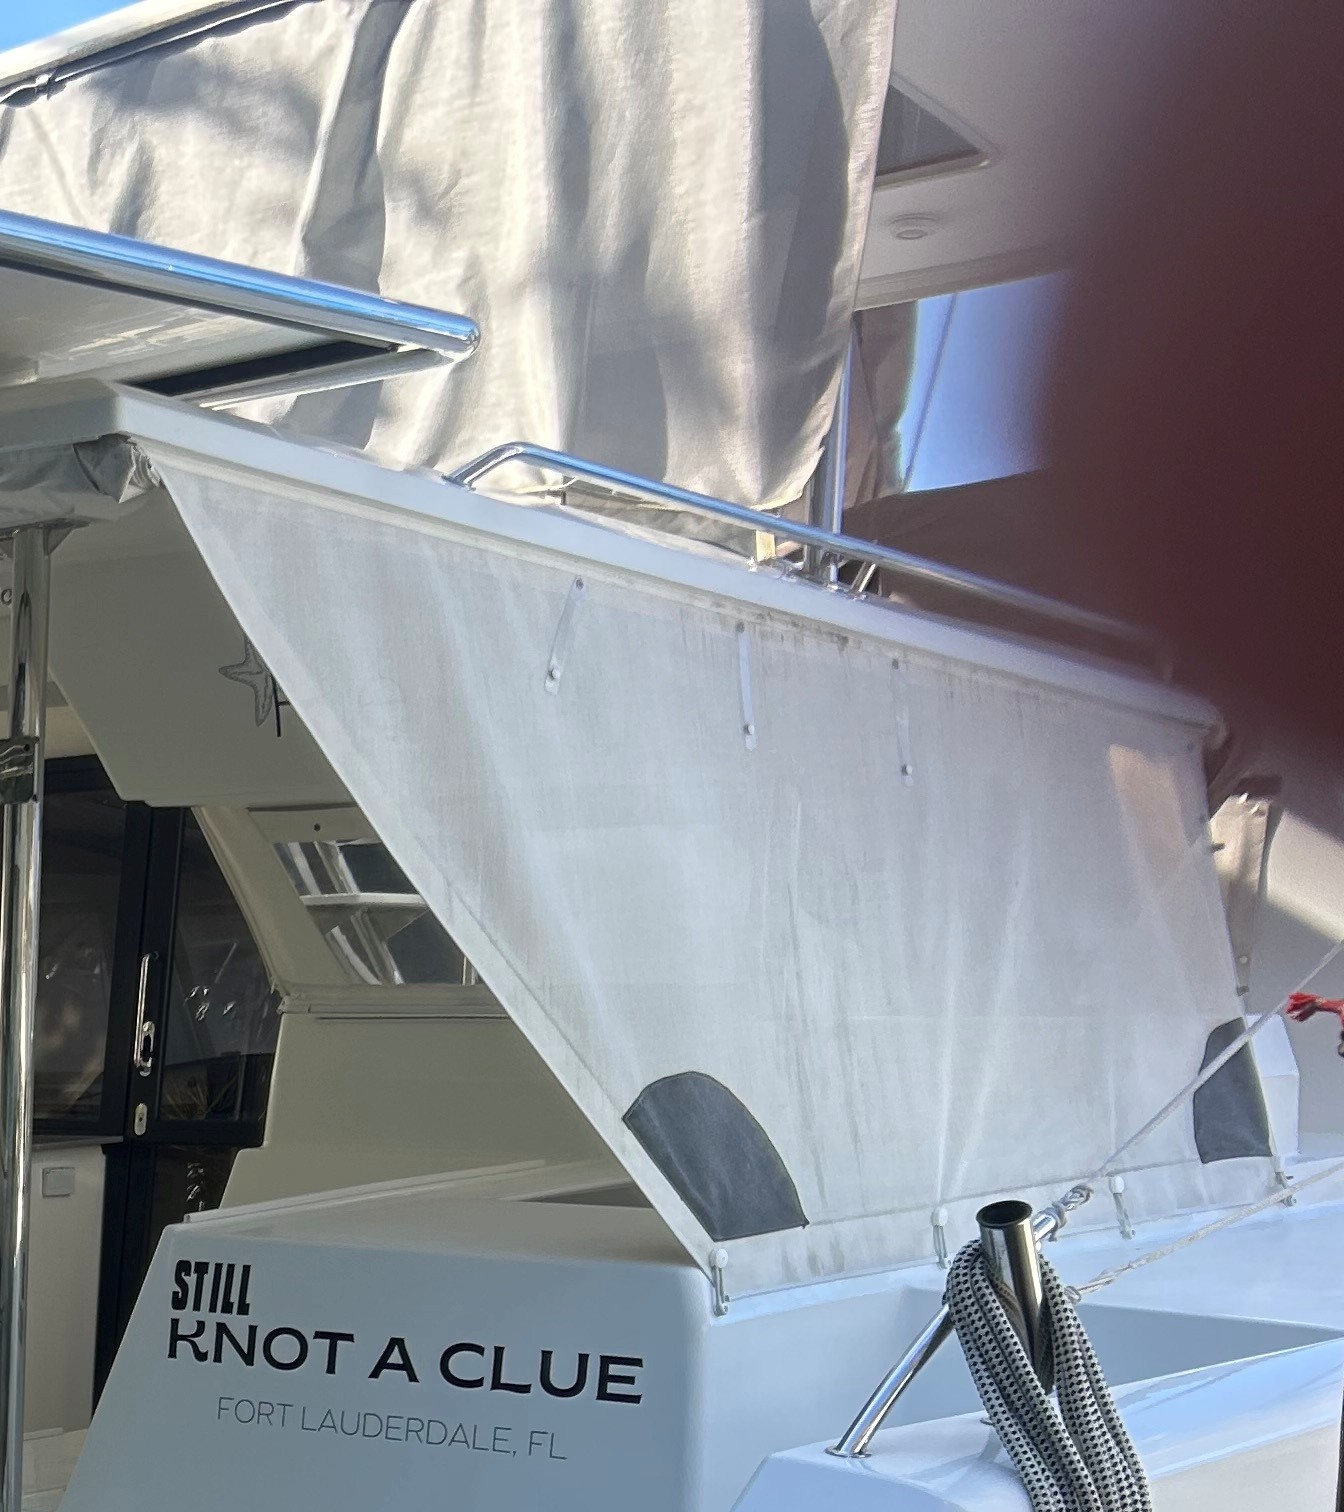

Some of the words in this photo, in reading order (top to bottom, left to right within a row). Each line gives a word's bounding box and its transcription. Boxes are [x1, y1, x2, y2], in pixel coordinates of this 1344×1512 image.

[171, 1259, 252, 1316] STILL
[167, 1317, 355, 1376] KNOT
[367, 1337, 420, 1384] A
[439, 1342, 644, 1405] CLUE
[217, 1396, 294, 1428] FORT
[301, 1406, 517, 1458] LAUDERDALE,
[528, 1430, 568, 1461] FL
